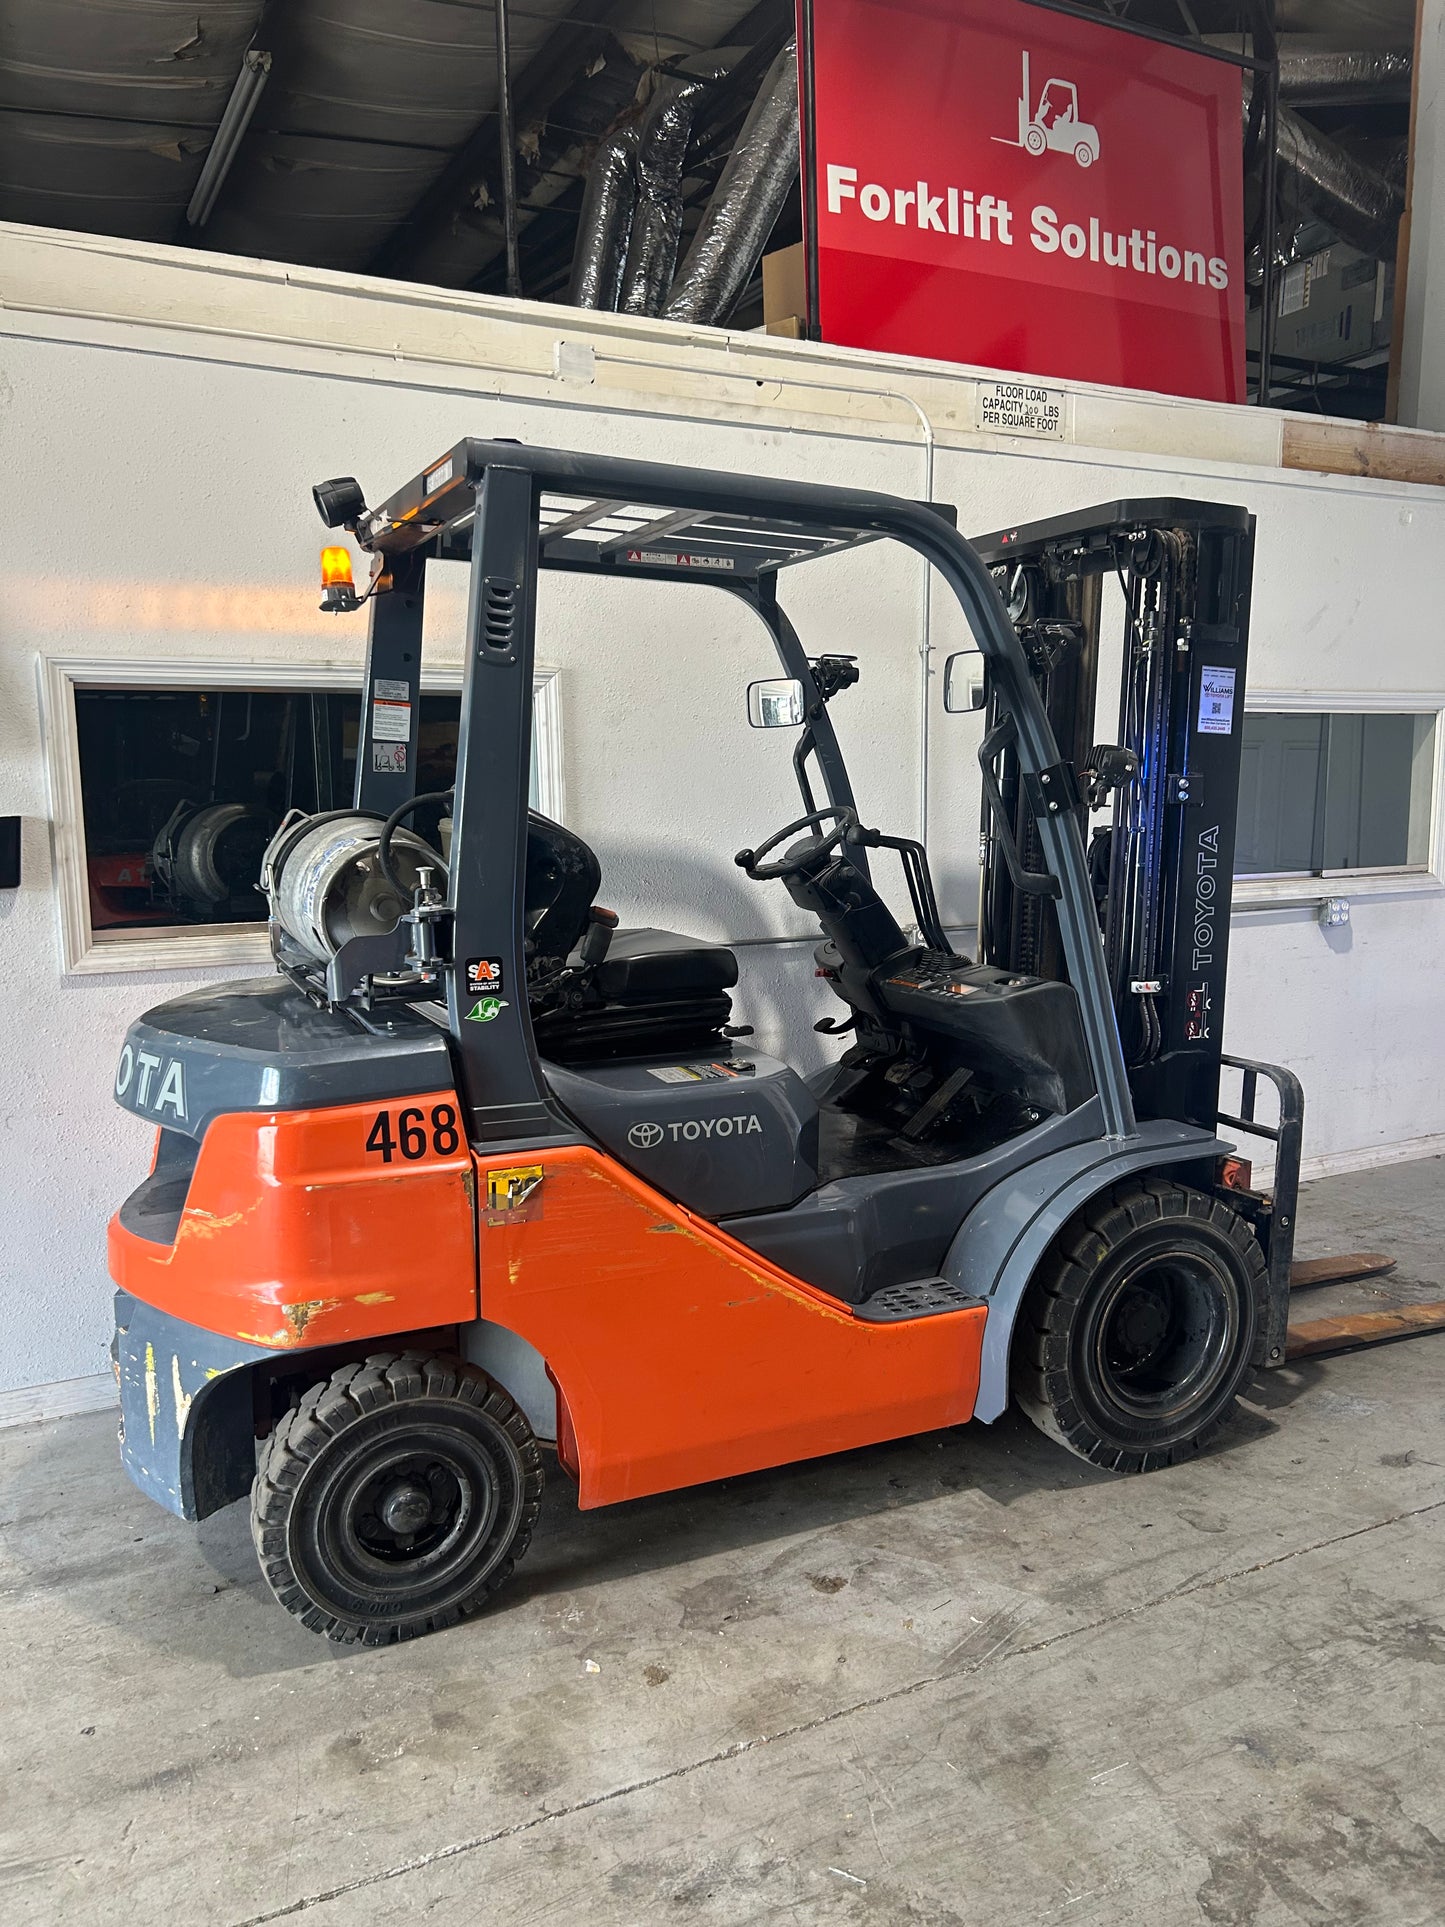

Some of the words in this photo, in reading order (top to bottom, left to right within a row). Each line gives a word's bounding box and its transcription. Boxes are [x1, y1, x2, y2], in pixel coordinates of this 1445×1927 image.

[826, 163, 1012, 246] Forklift
[1030, 205, 1229, 290] Solutions
[996, 385, 1024, 400] FLOOR
[1025, 389, 1048, 402] LOAD
[982, 397, 1023, 413] CAPACITY
[1043, 405, 1060, 418] LBS
[983, 411, 1000, 424] PER
[1001, 413, 1036, 428] SQUARE
[1036, 417, 1059, 431] FOOT
[1203, 681, 1233, 695] WILLIAMS
[1192, 825, 1220, 971] TOYOTA
[468, 961, 500, 981] SAS
[366, 1103, 460, 1163] 468
[667, 1114, 763, 1142] TOYOTA
